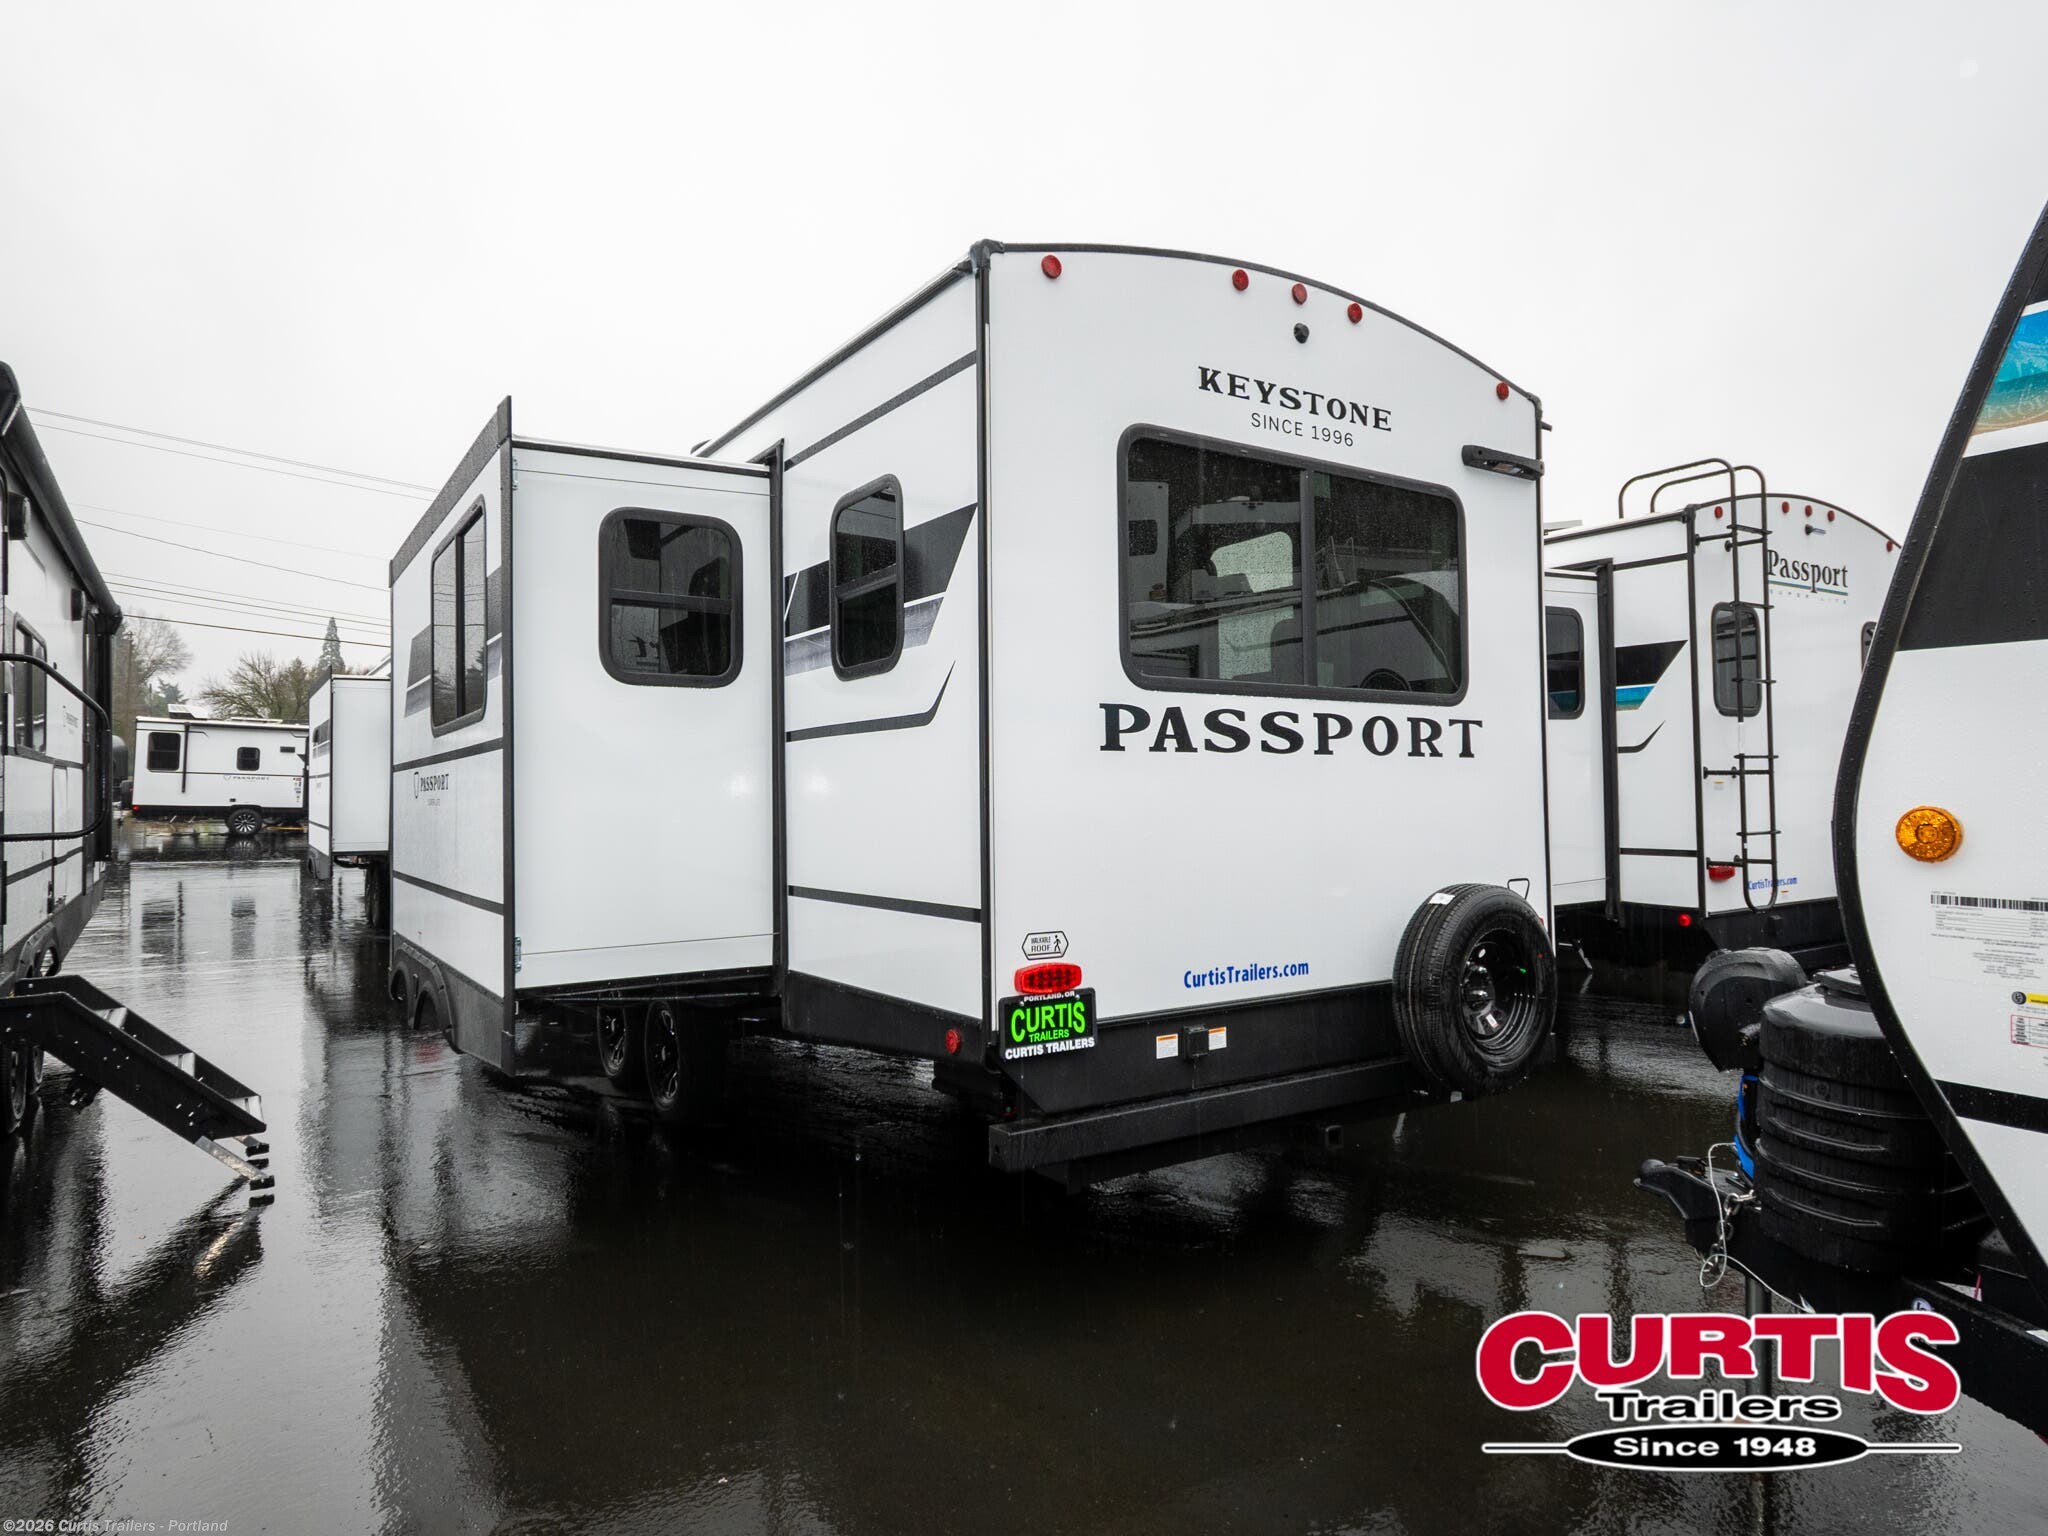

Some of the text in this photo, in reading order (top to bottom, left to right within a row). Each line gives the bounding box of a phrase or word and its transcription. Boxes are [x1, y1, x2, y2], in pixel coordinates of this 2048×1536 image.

[1198, 366, 1392, 432] KEYSTONE
[1251, 412, 1354, 447] SINCE 1996
[1767, 549, 1848, 593] Passport
[1099, 702, 1483, 758] PASSPORT
[420, 773, 449, 792] PASSPORT
[1031, 944, 1051, 953] ROOF
[1184, 962, 1309, 988] CurtisTrailers.com
[1024, 990, 1075, 1002] PORTLAND, OR
[1011, 1001, 1086, 1043] CURTIS
[1005, 1037, 1095, 1060] CURTIS TRAILERS
[1029, 1029, 1070, 1043] TRAILERS
